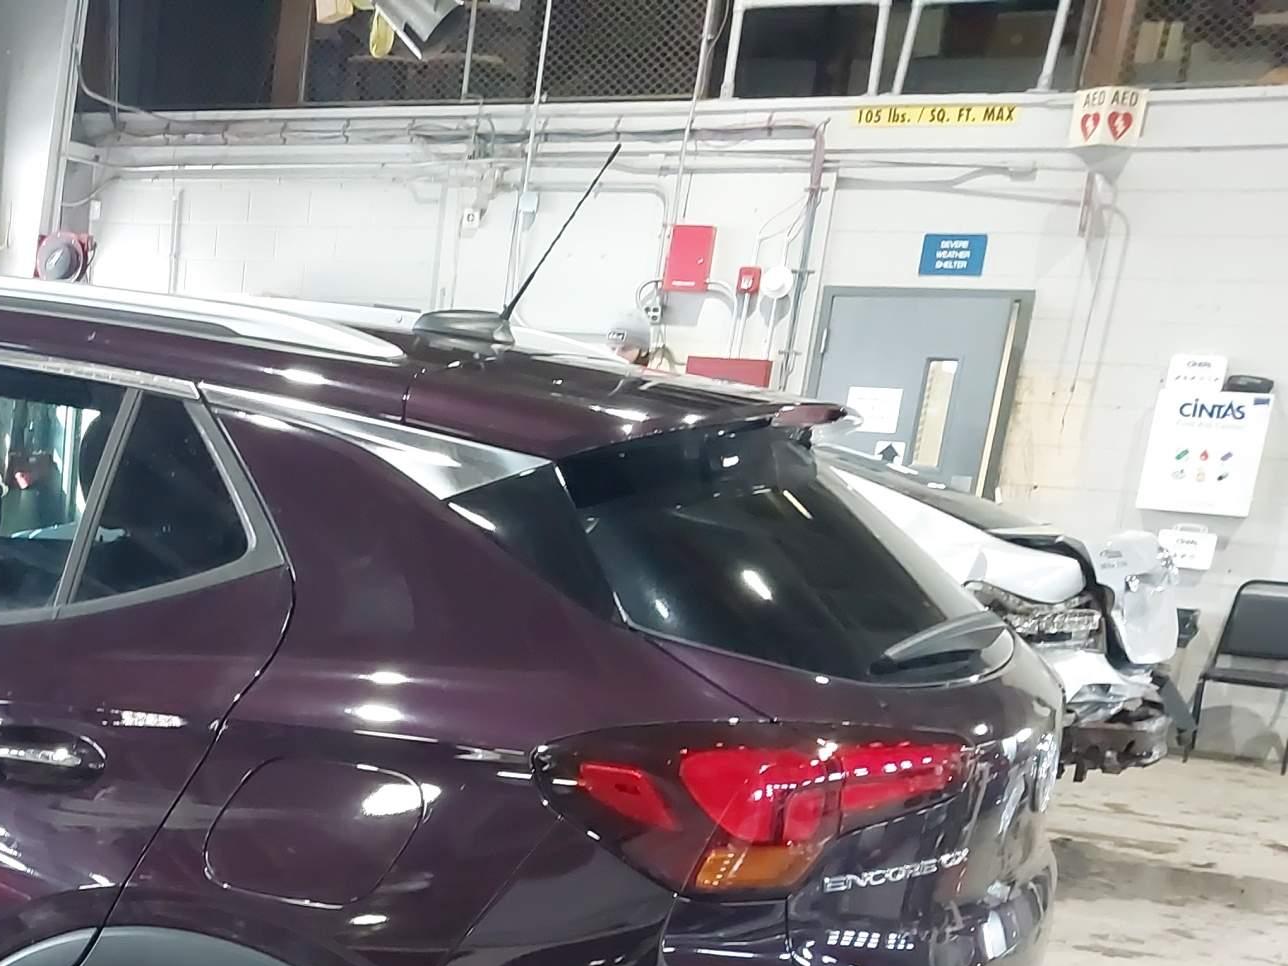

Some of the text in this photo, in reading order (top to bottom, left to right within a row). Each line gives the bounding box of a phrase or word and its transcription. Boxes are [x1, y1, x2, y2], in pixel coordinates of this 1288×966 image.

[1082, 89, 1105, 108] AED
[1110, 89, 1140, 108] AED
[857, 106, 1016, 124] 105 lbs. / SQ. FT. MAX
[823, 857, 938, 893] ENCORE
